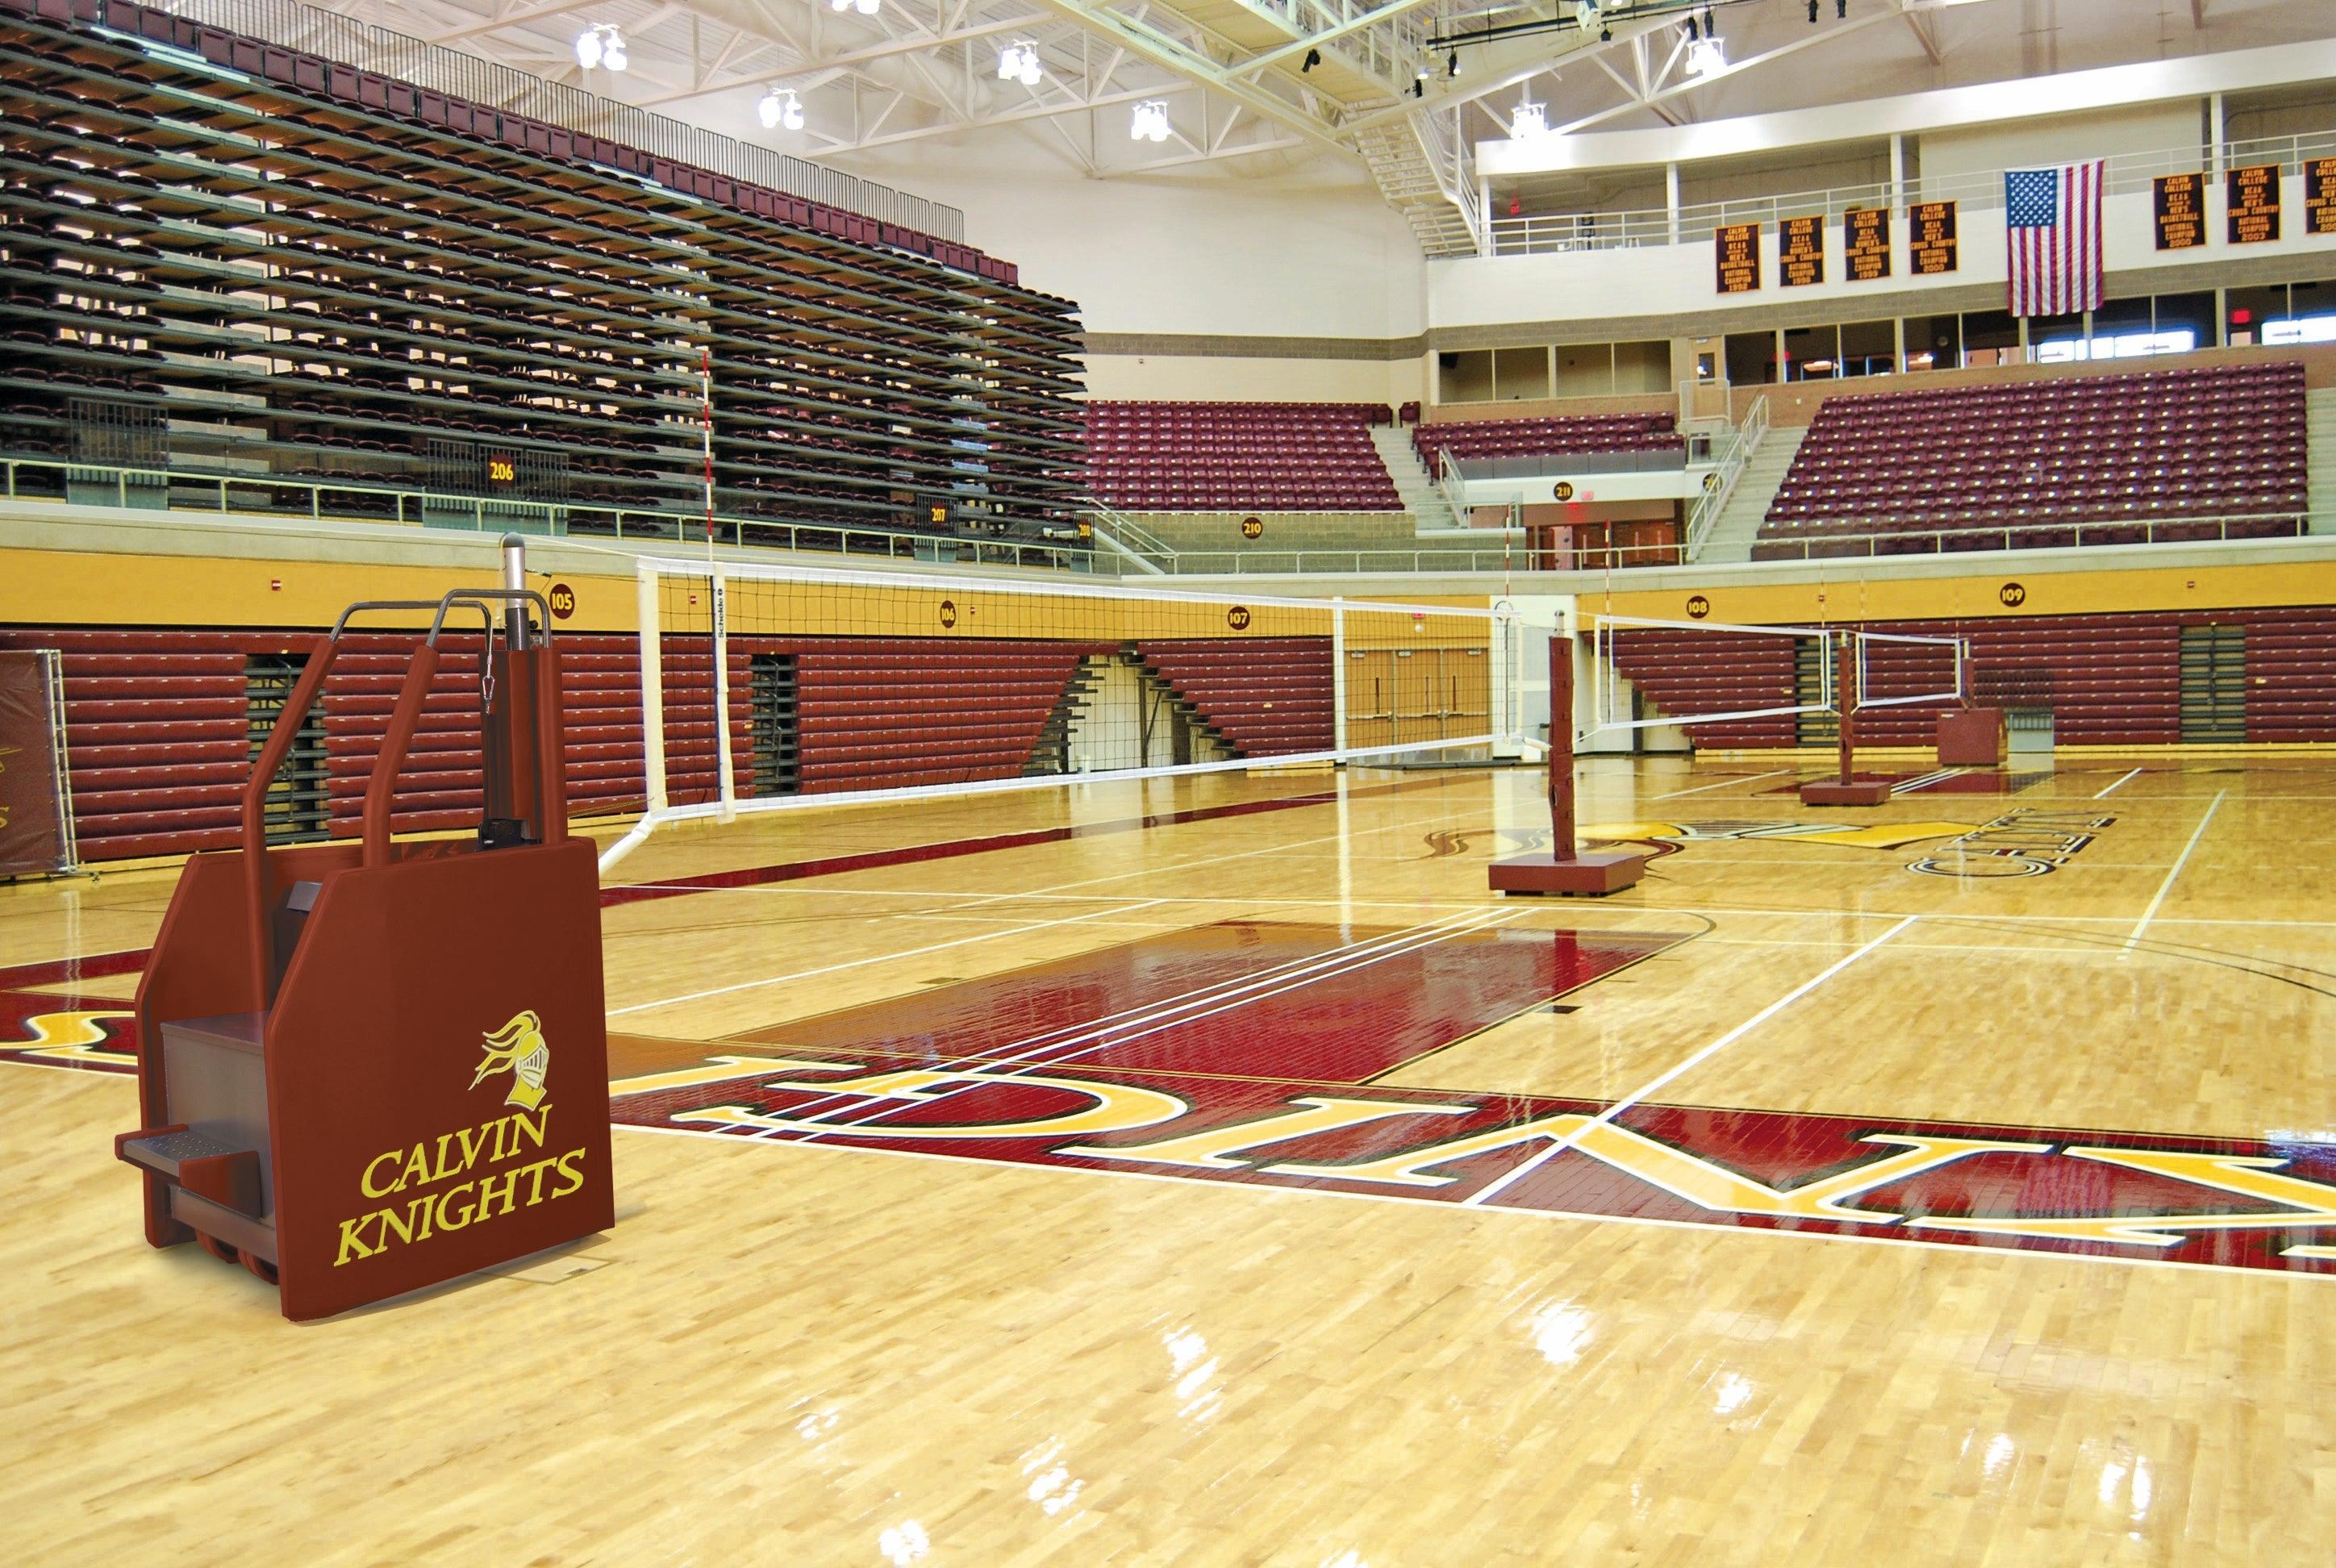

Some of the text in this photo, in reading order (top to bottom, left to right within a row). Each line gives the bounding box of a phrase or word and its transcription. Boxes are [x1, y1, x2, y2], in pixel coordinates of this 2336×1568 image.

[490, 462, 514, 481] 206
[1557, 486, 1571, 497] 211
[932, 508, 945, 522] 207
[1244, 523, 1262, 534] 210
[553, 593, 573, 610] 105
[2002, 589, 2023, 602] 109
[1688, 601, 1707, 614] 108
[941, 608, 954, 621] 106
[1230, 612, 1248, 624] 107
[361, 1104, 553, 1199] CALVIN
[333, 1148, 586, 1267] KNIGHTS
